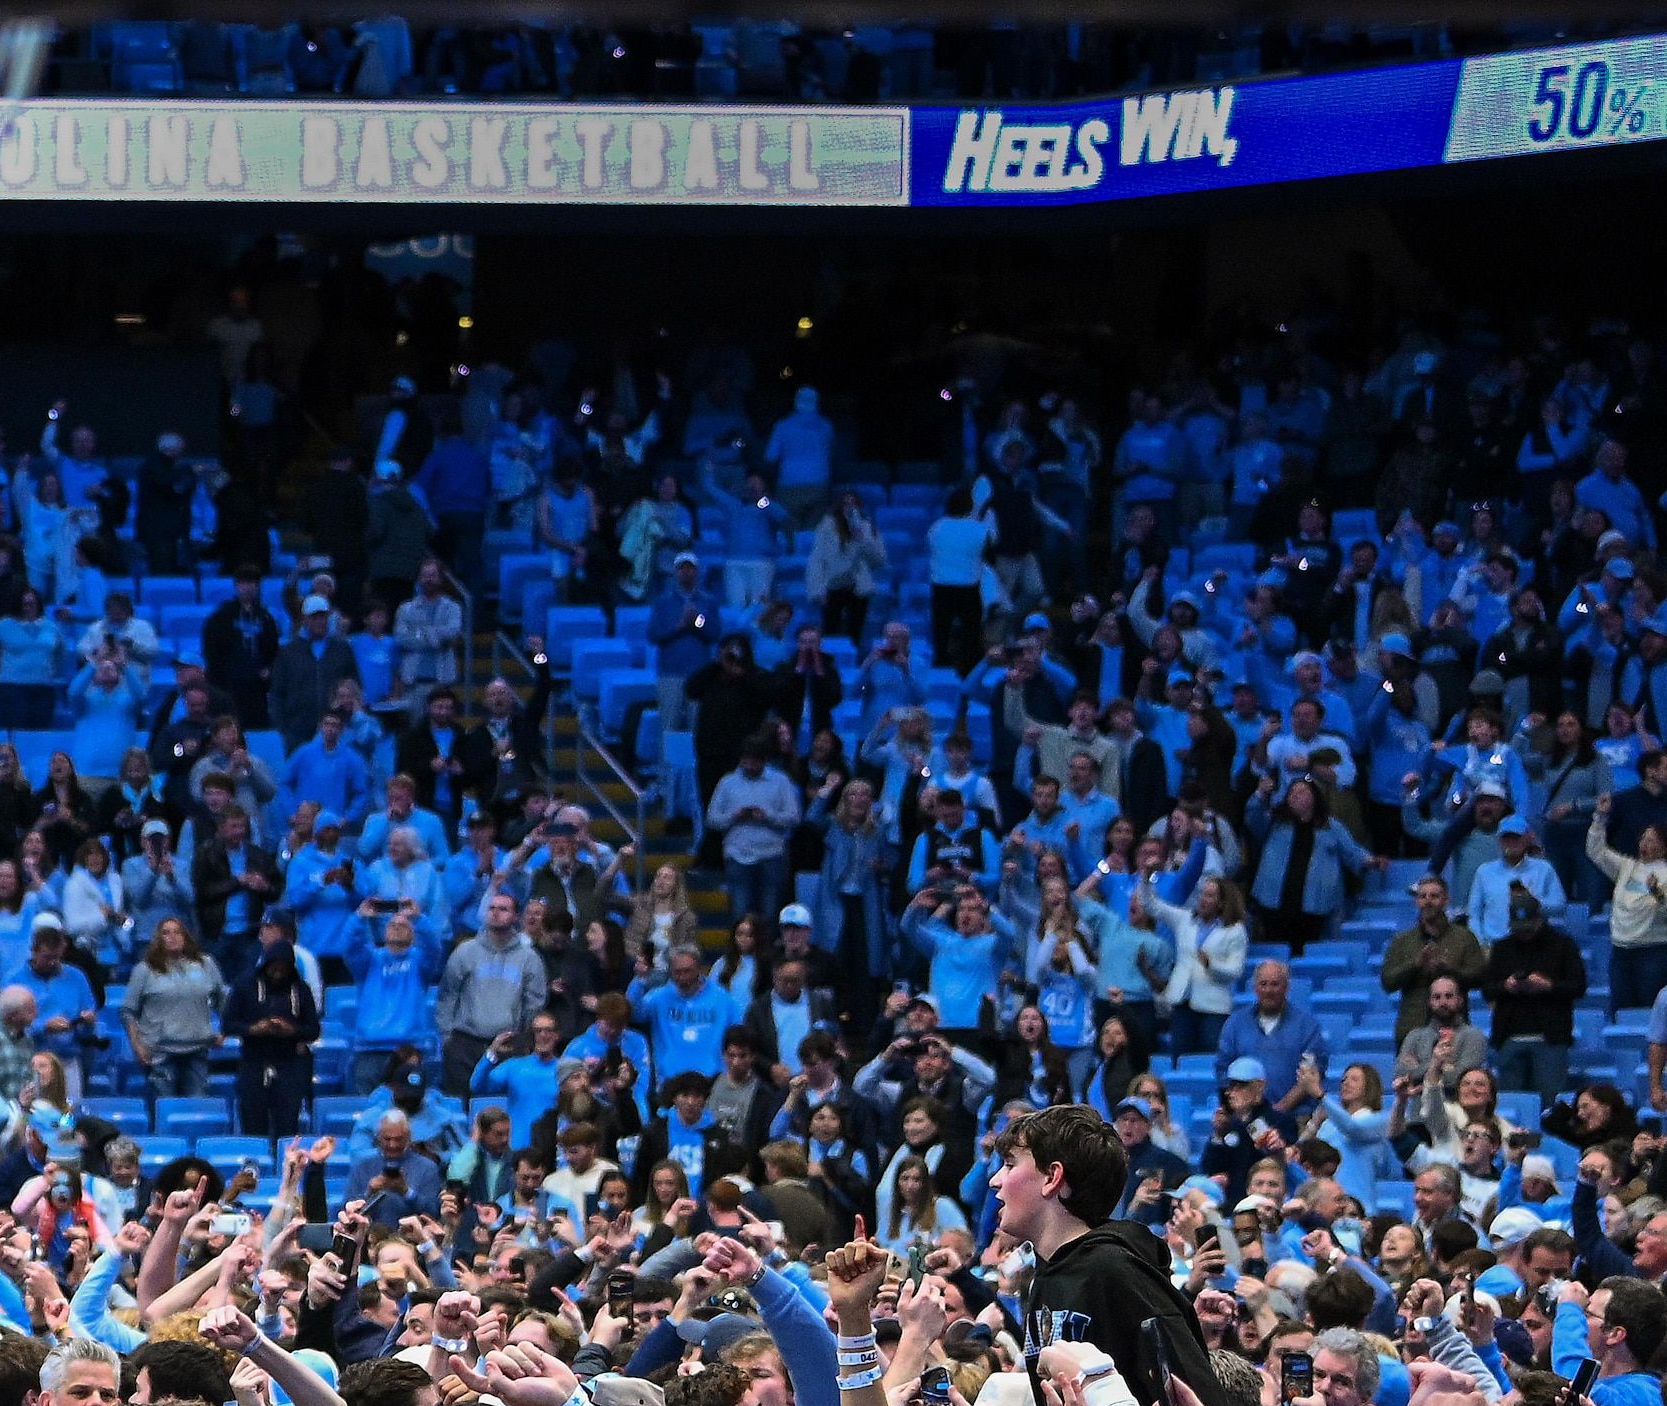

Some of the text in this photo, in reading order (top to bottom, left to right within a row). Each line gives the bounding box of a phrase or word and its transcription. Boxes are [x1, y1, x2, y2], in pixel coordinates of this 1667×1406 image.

[943, 85, 1238, 192] HEELS WIN,
[1528, 61, 1648, 142] 50%
[298, 114, 823, 192] BASKETBALL
